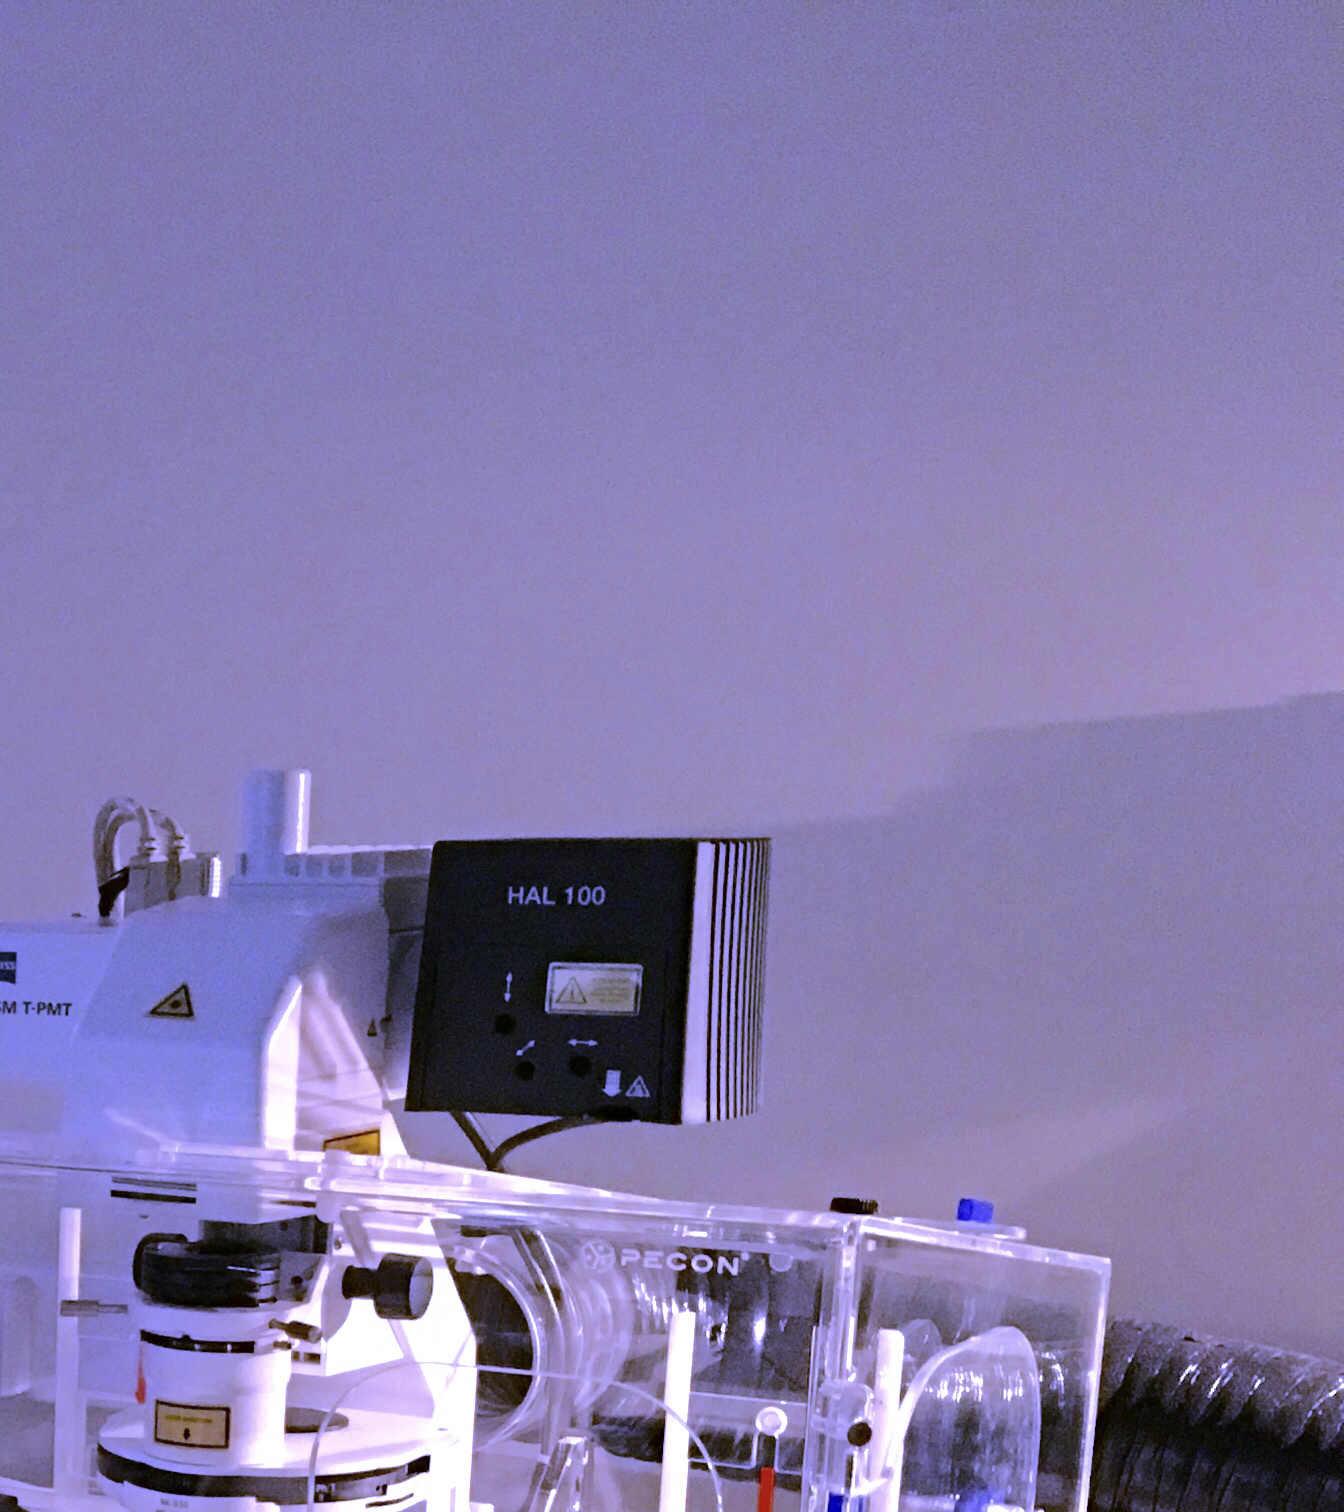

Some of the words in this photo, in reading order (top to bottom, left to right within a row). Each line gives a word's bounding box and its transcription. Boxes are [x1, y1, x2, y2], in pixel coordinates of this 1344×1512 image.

[508, 886, 556, 905] HAL
[565, 886, 606, 906] 100
[22, 1001, 72, 1016] T-PMT
[621, 1248, 739, 1276] PECON
